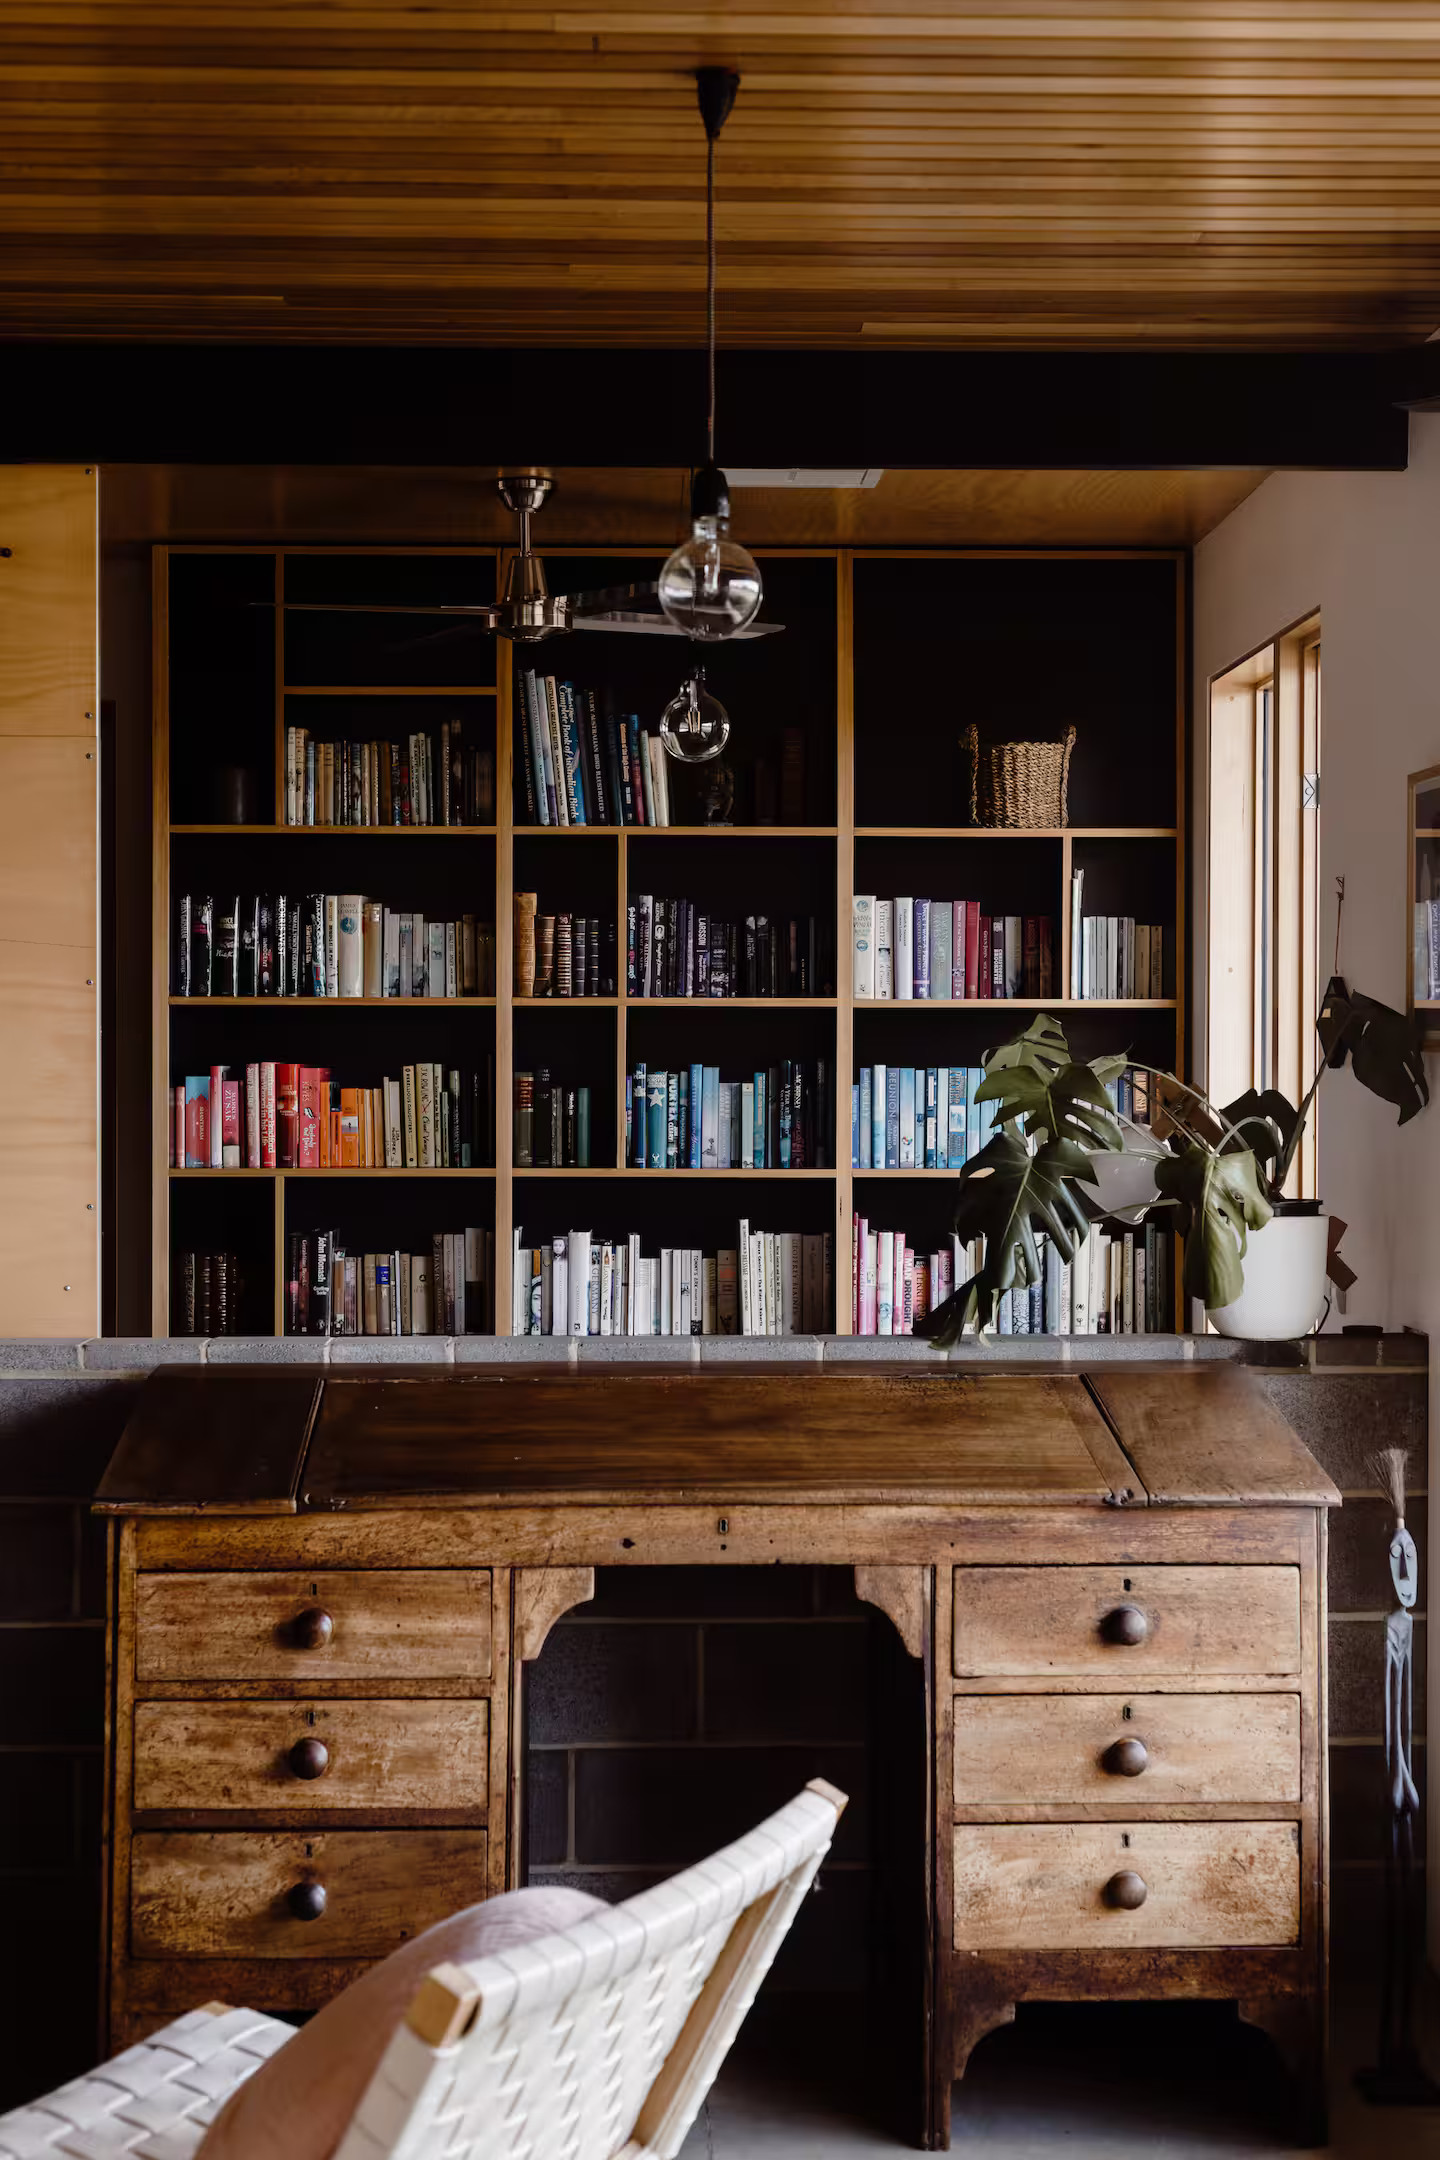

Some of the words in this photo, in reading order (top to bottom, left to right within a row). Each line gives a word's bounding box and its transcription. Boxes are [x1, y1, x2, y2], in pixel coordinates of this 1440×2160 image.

[559, 685, 569, 724] Complete
[562, 724, 571, 745] Book
[564, 754, 577, 798] Australian
[569, 798, 579, 820] Birds
[698, 918, 706, 946] LARSSON
[879, 903, 888, 946] Vincenzi
[668, 1078, 678, 1121] VORTEX
[888, 1072, 897, 1118] REUNION
[317, 1236, 327, 1253] John
[317, 1254, 327, 1283] Monash
[591, 1267, 600, 1314] GERMANY
[904, 1280, 912, 1324] DROUGHT
